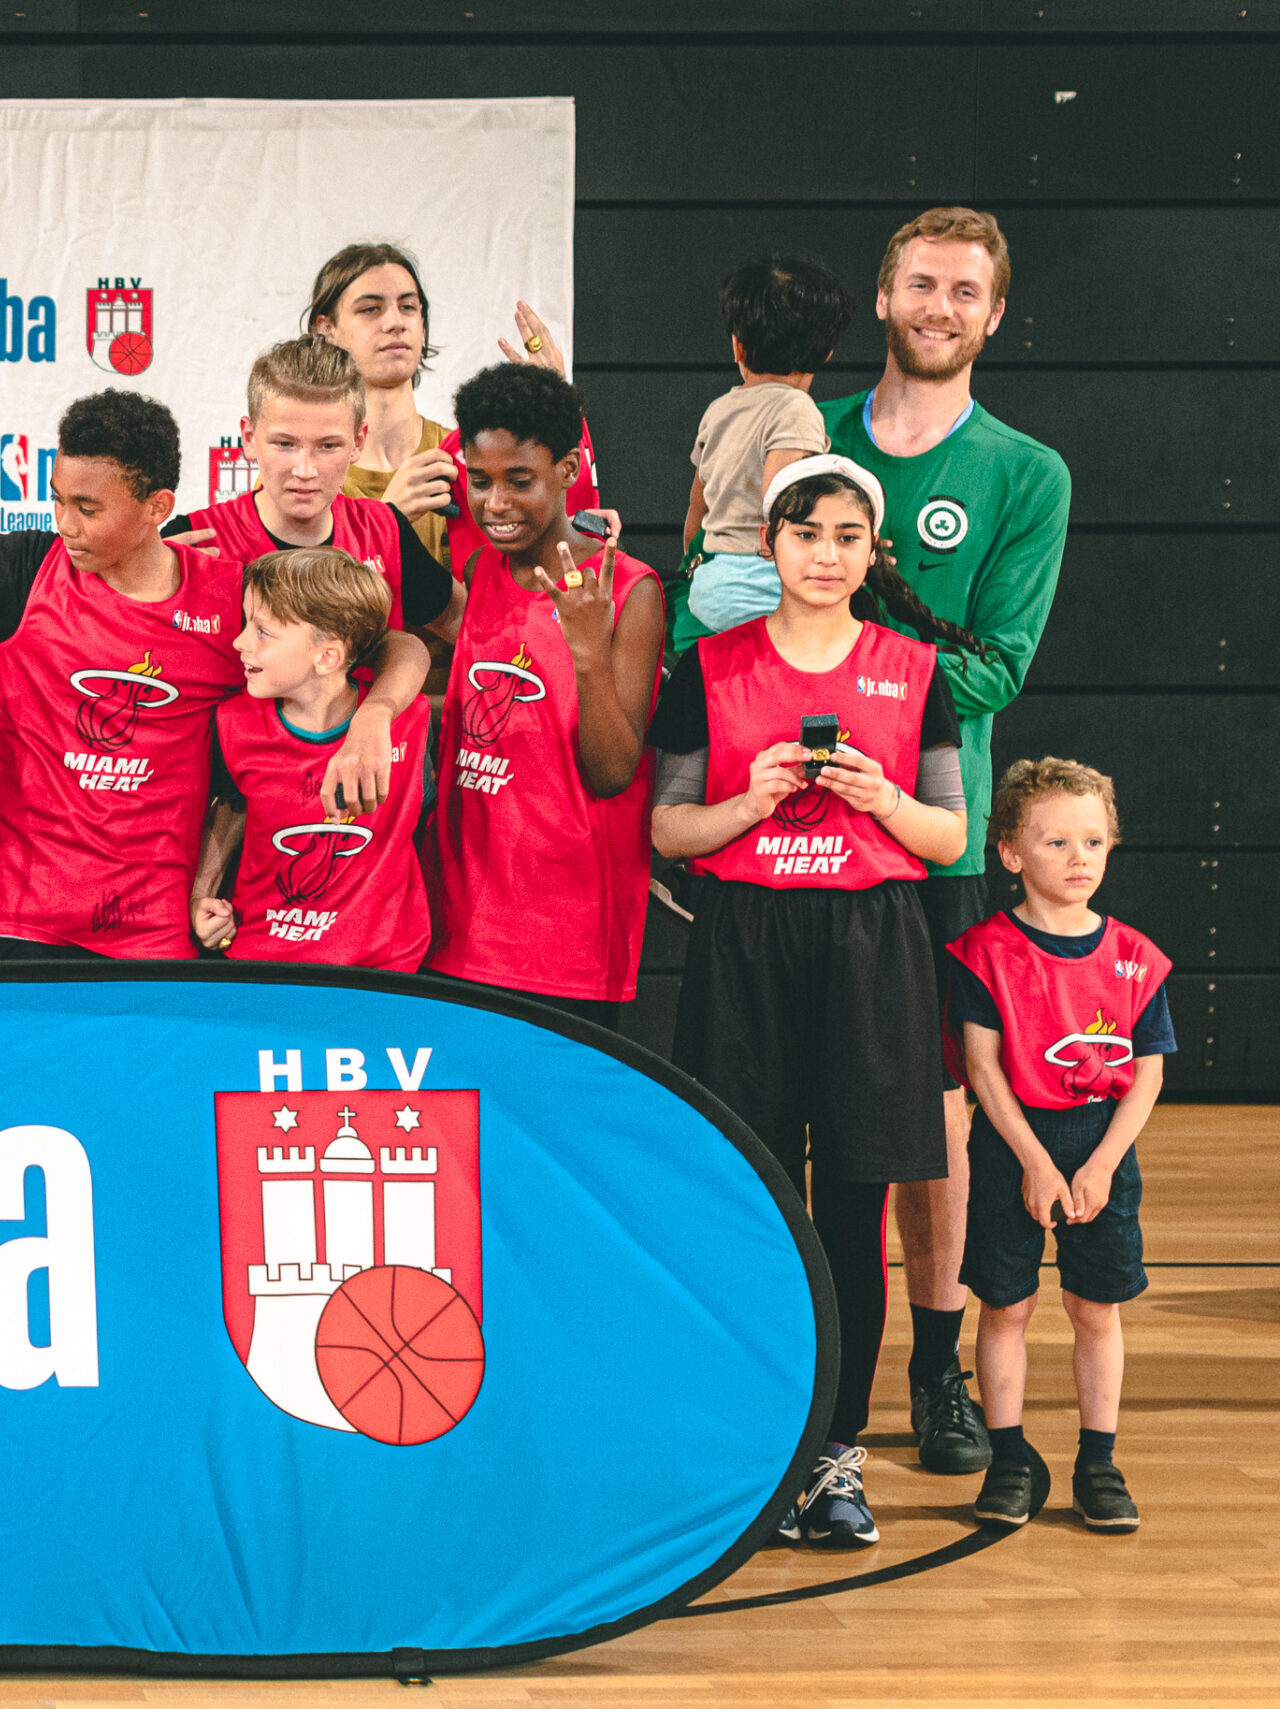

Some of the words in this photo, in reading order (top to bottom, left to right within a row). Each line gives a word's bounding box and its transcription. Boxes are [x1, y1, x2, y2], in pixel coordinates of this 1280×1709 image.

[97, 277, 142, 289] HBV
[866, 677, 899, 699] jr.nba
[63, 751, 150, 775] MIAMI
[79, 767, 155, 792] HEAT
[755, 835, 844, 855] MIAMI
[773, 848, 853, 875] HEAT
[258, 1047, 433, 1092] HBV
